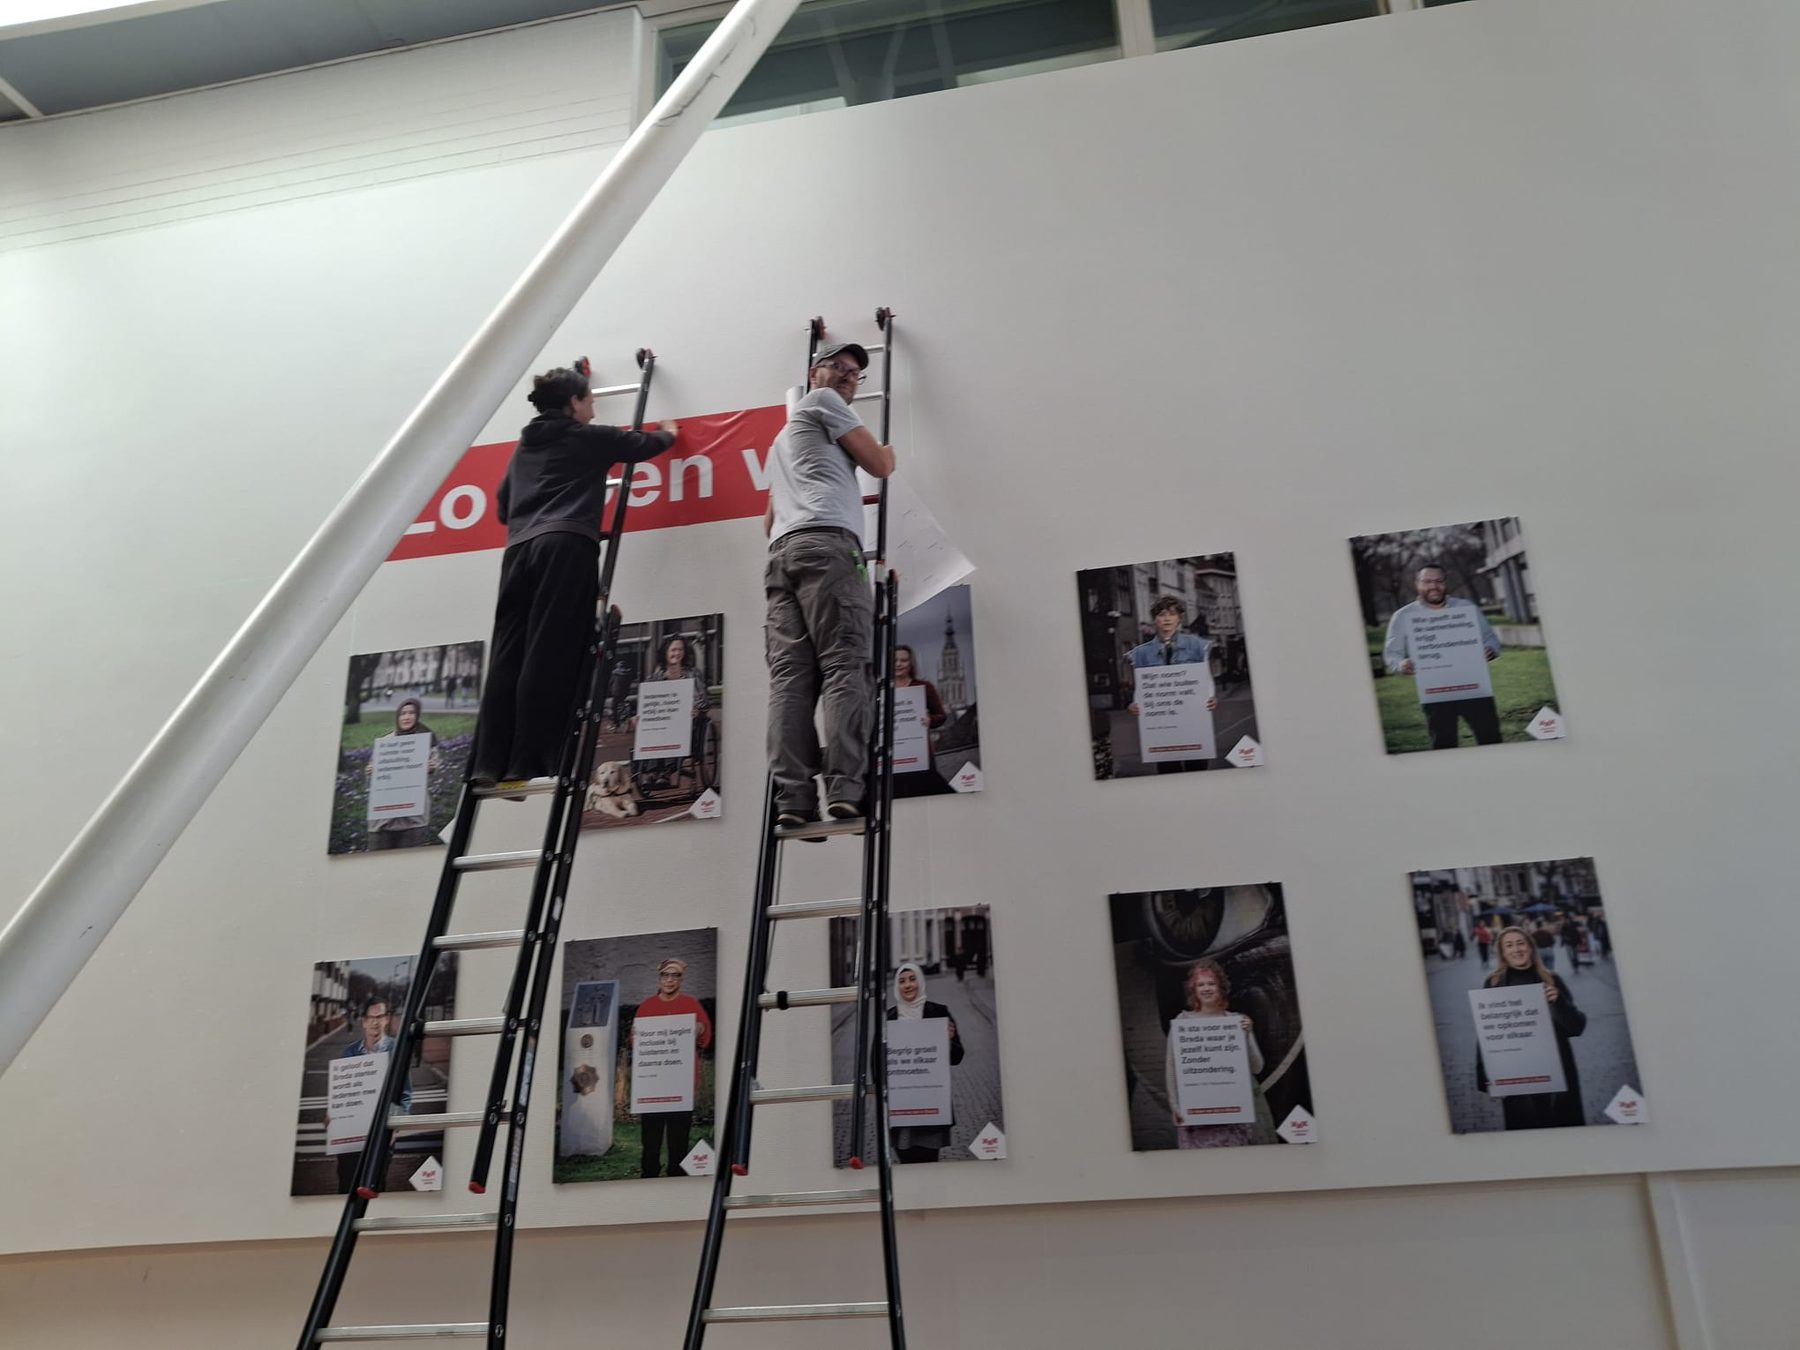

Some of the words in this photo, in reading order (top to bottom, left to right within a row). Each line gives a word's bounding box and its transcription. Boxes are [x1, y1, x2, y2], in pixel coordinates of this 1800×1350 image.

[1480, 1010, 1522, 1020] belangrijk
[1497, 1020, 1537, 1030] opkomen
[1228, 1034, 1236, 1042] je
[1180, 1045, 1202, 1055] jezelf
[1224, 1044, 1242, 1052] zijn.
[1182, 1056, 1211, 1064] Zonder
[1183, 1066, 1236, 1074] uitzondering.
